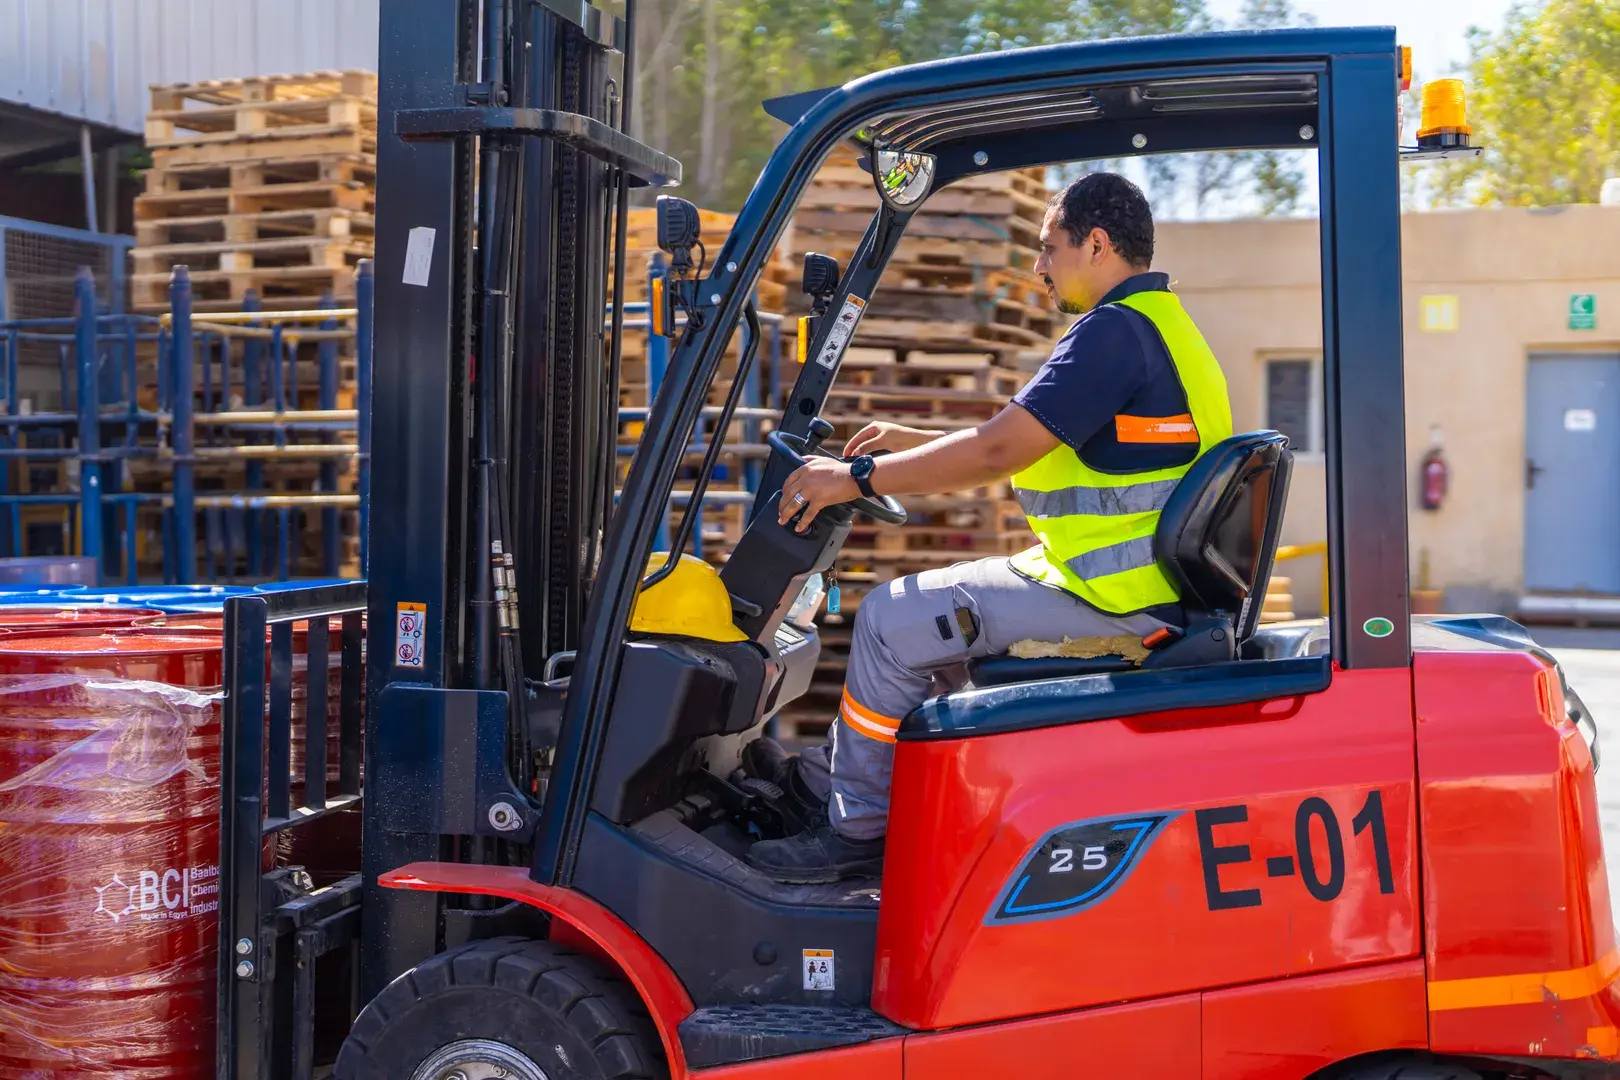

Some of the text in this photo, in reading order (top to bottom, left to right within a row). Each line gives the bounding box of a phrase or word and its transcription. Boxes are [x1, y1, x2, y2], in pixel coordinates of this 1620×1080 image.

[1049, 846, 1108, 873] 25
[1195, 789, 1395, 911] E-01
[140, 868, 188, 910] BCI
[190, 881, 220, 897] Chemi
[168, 910, 188, 920] Egypt
